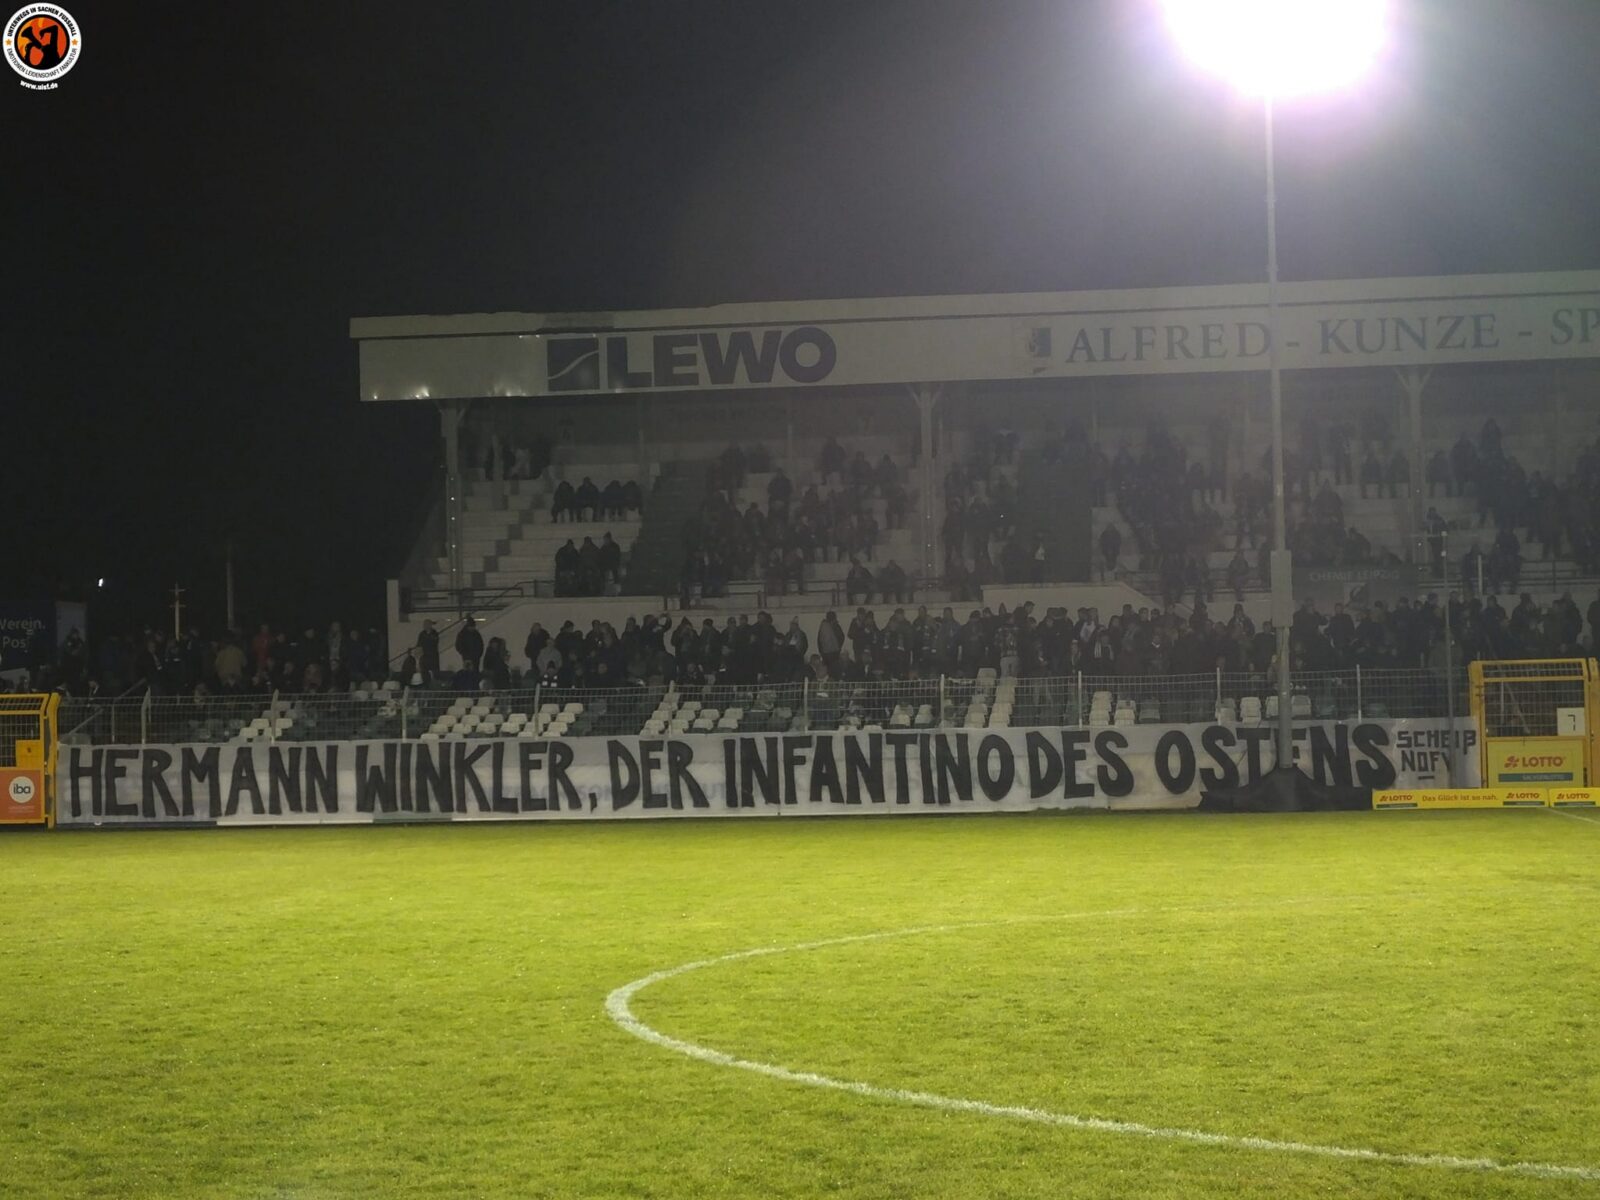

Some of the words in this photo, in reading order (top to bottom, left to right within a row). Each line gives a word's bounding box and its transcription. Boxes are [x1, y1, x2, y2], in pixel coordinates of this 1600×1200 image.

[606, 327, 837, 390] LEWO
[1065, 321, 1272, 363] ALFRED
[1317, 312, 1499, 356] KUNZE
[69, 744, 339, 818] HERMANN
[354, 741, 598, 814] WINKLER,
[606, 739, 711, 811] DER
[723, 732, 1015, 808] INFANTINO
[1025, 729, 1135, 799] DES
[1521, 755, 1564, 768] LOTTO
[13, 783, 31, 795] iba
